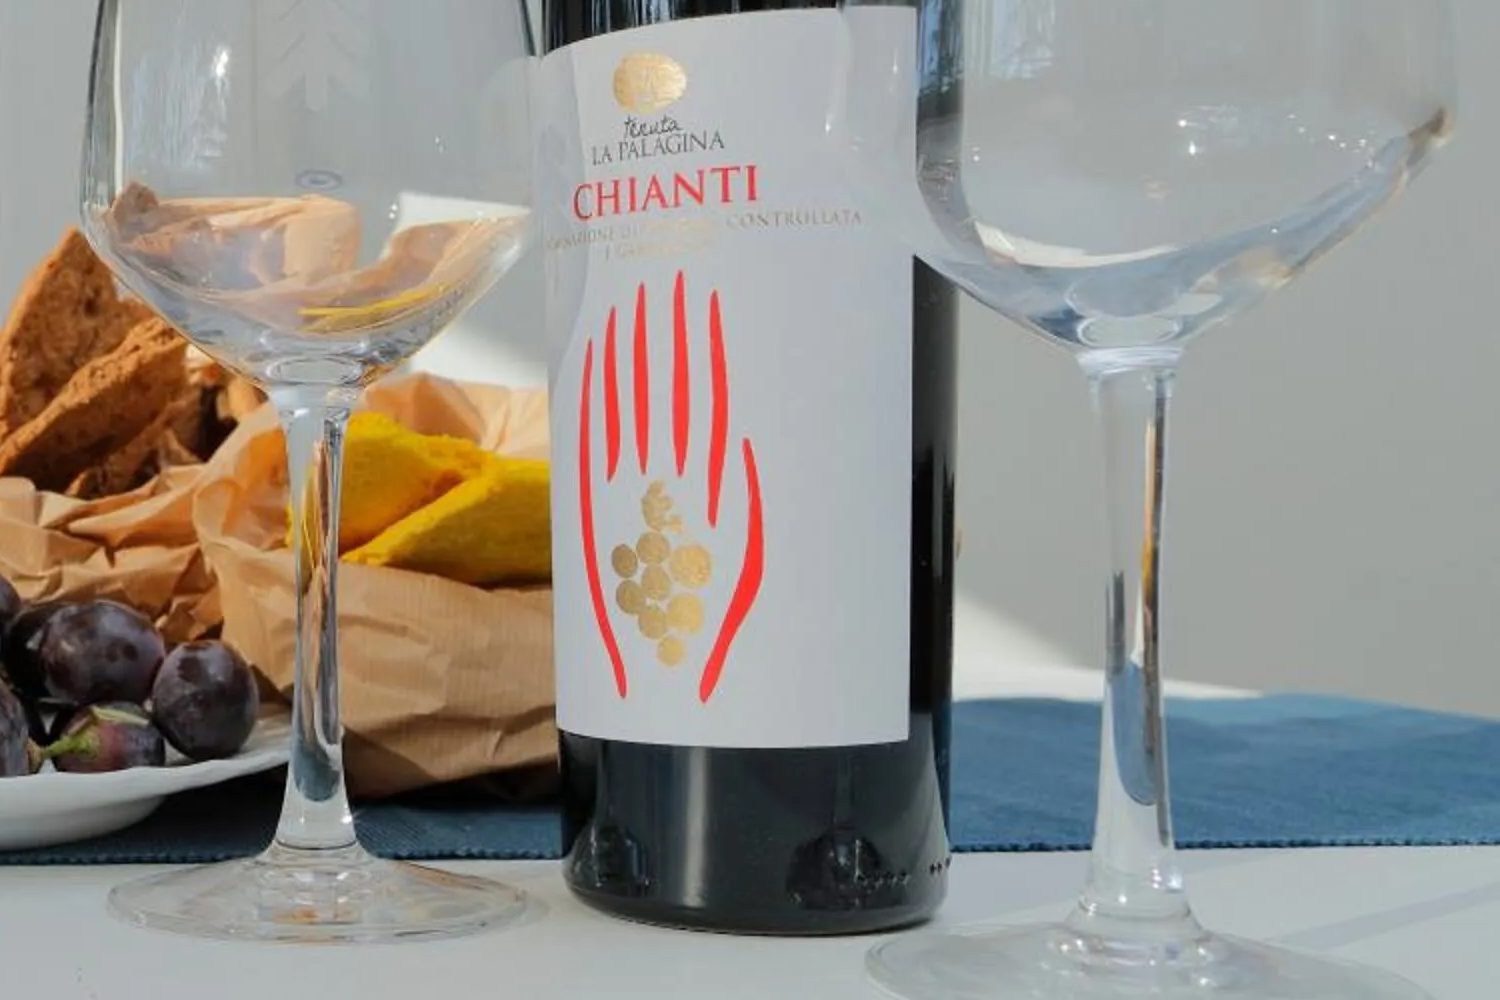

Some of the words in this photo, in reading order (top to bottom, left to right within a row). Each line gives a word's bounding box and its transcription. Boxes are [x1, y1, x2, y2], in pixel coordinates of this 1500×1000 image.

[592, 144, 613, 166] LA
[618, 129, 725, 162] PALAGINA
[573, 164, 757, 222] CHIANTI
